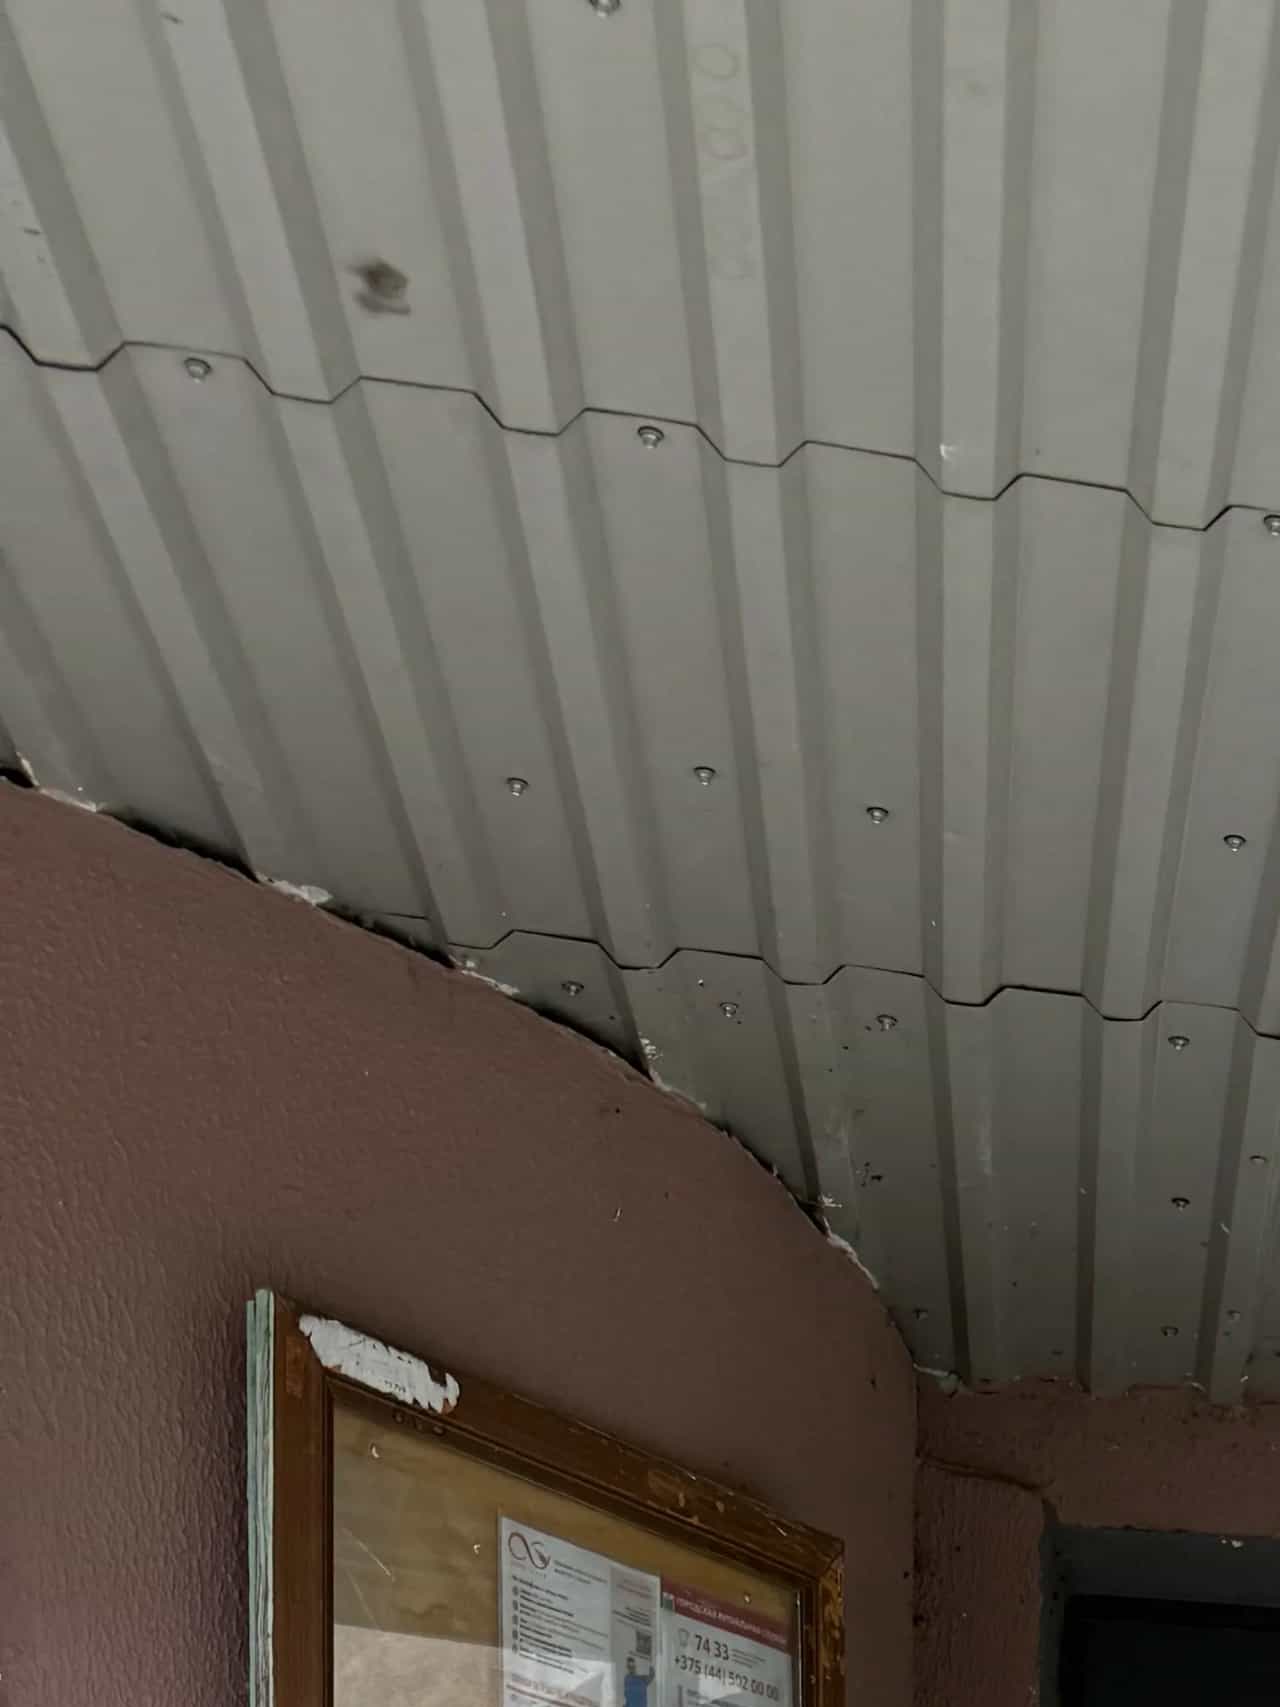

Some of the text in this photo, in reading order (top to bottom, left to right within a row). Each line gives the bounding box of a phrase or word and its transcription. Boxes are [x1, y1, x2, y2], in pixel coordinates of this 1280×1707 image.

[695, 1634, 711, 1656] 74
[714, 1640, 730, 1661] 33
[675, 1655, 701, 1676] +375
